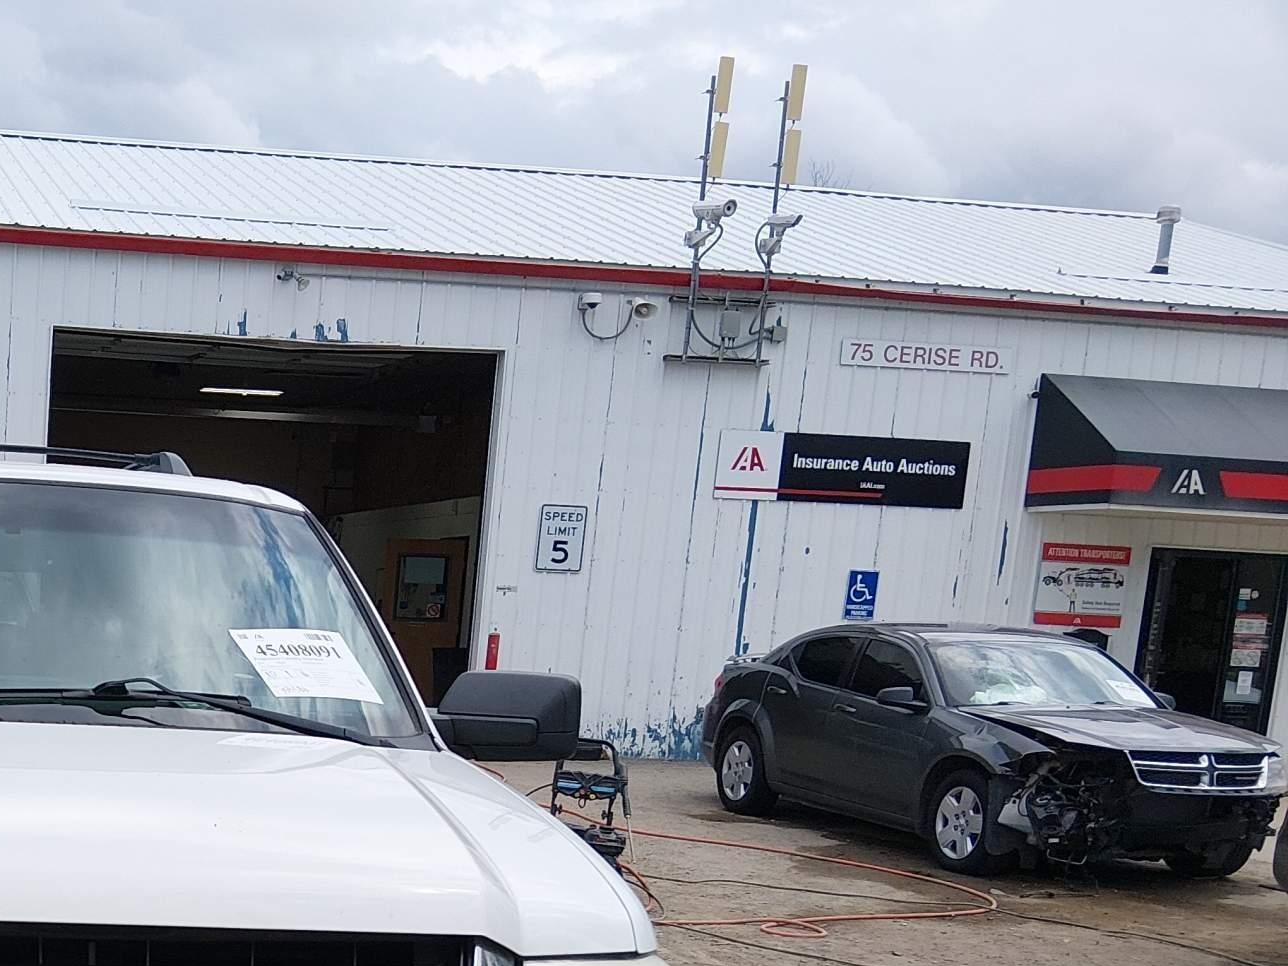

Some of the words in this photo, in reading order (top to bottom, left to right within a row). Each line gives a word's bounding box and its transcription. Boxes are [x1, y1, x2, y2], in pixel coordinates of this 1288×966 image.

[850, 343, 873, 361] 75
[883, 345, 961, 366] CERISE
[970, 350, 1004, 369] RD.
[792, 453, 859, 471] Insurance
[862, 456, 894, 473] Auto
[896, 458, 957, 476] Auctions
[544, 511, 584, 522] SPEED
[546, 526, 578, 537] LIMIT
[550, 540, 569, 564] 5
[256, 643, 341, 660] 45408091
